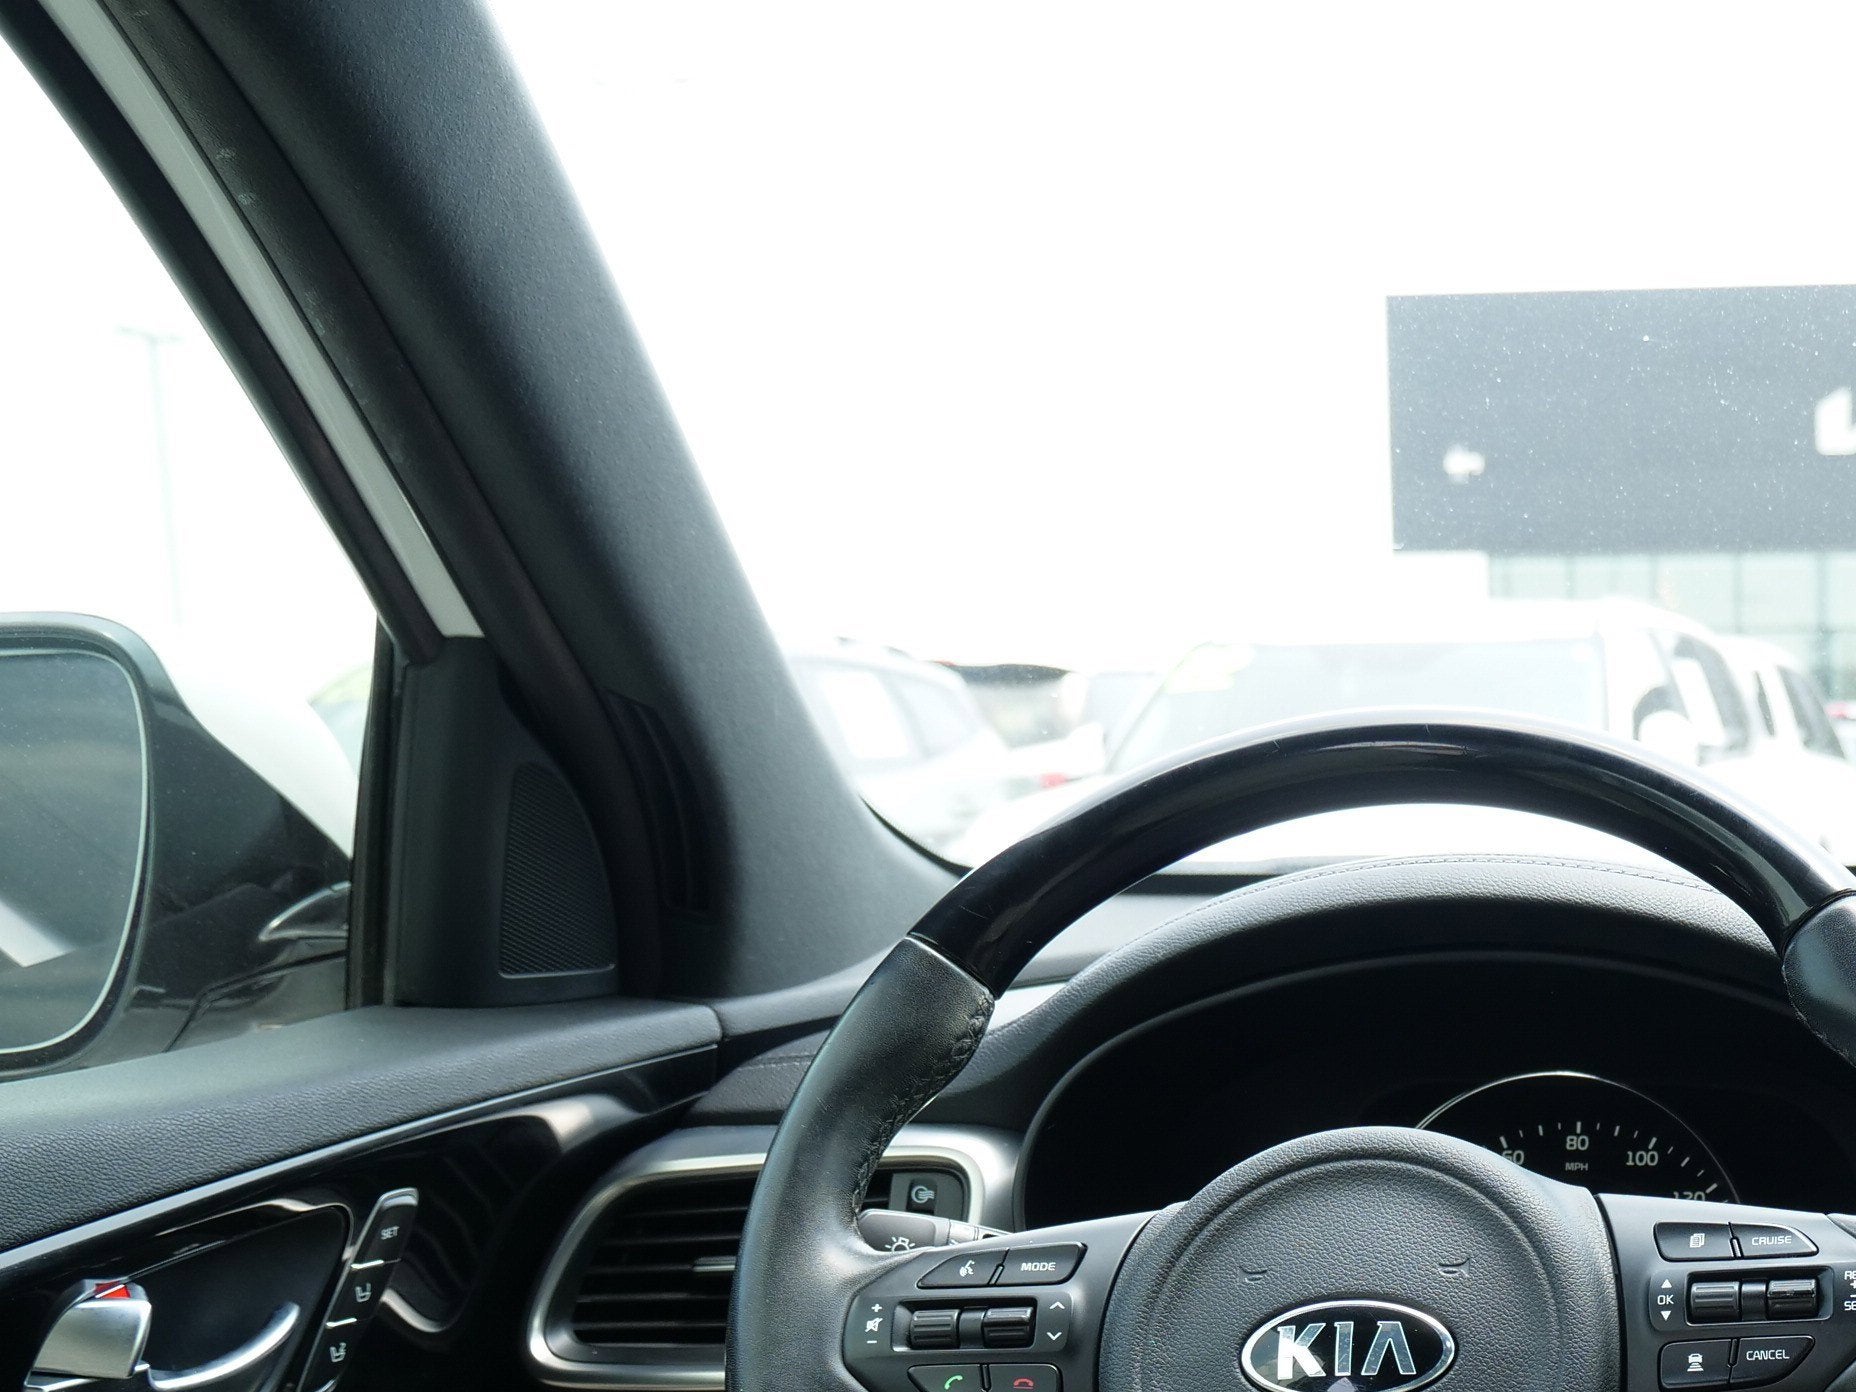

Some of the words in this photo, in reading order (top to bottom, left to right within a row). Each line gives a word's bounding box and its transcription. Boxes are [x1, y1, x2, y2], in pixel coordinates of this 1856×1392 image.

[1565, 1135, 1590, 1151] 80
[1625, 1151, 1659, 1167] 100
[1565, 1162, 1589, 1171] MPH
[380, 1226, 400, 1240] SET
[1751, 1235, 1793, 1246] CRUISE
[1020, 1262, 1056, 1272] MODE
[1657, 1294, 1674, 1306] OK
[1276, 1320, 1417, 1381] KIA
[1746, 1349, 1790, 1361] CANCEL
